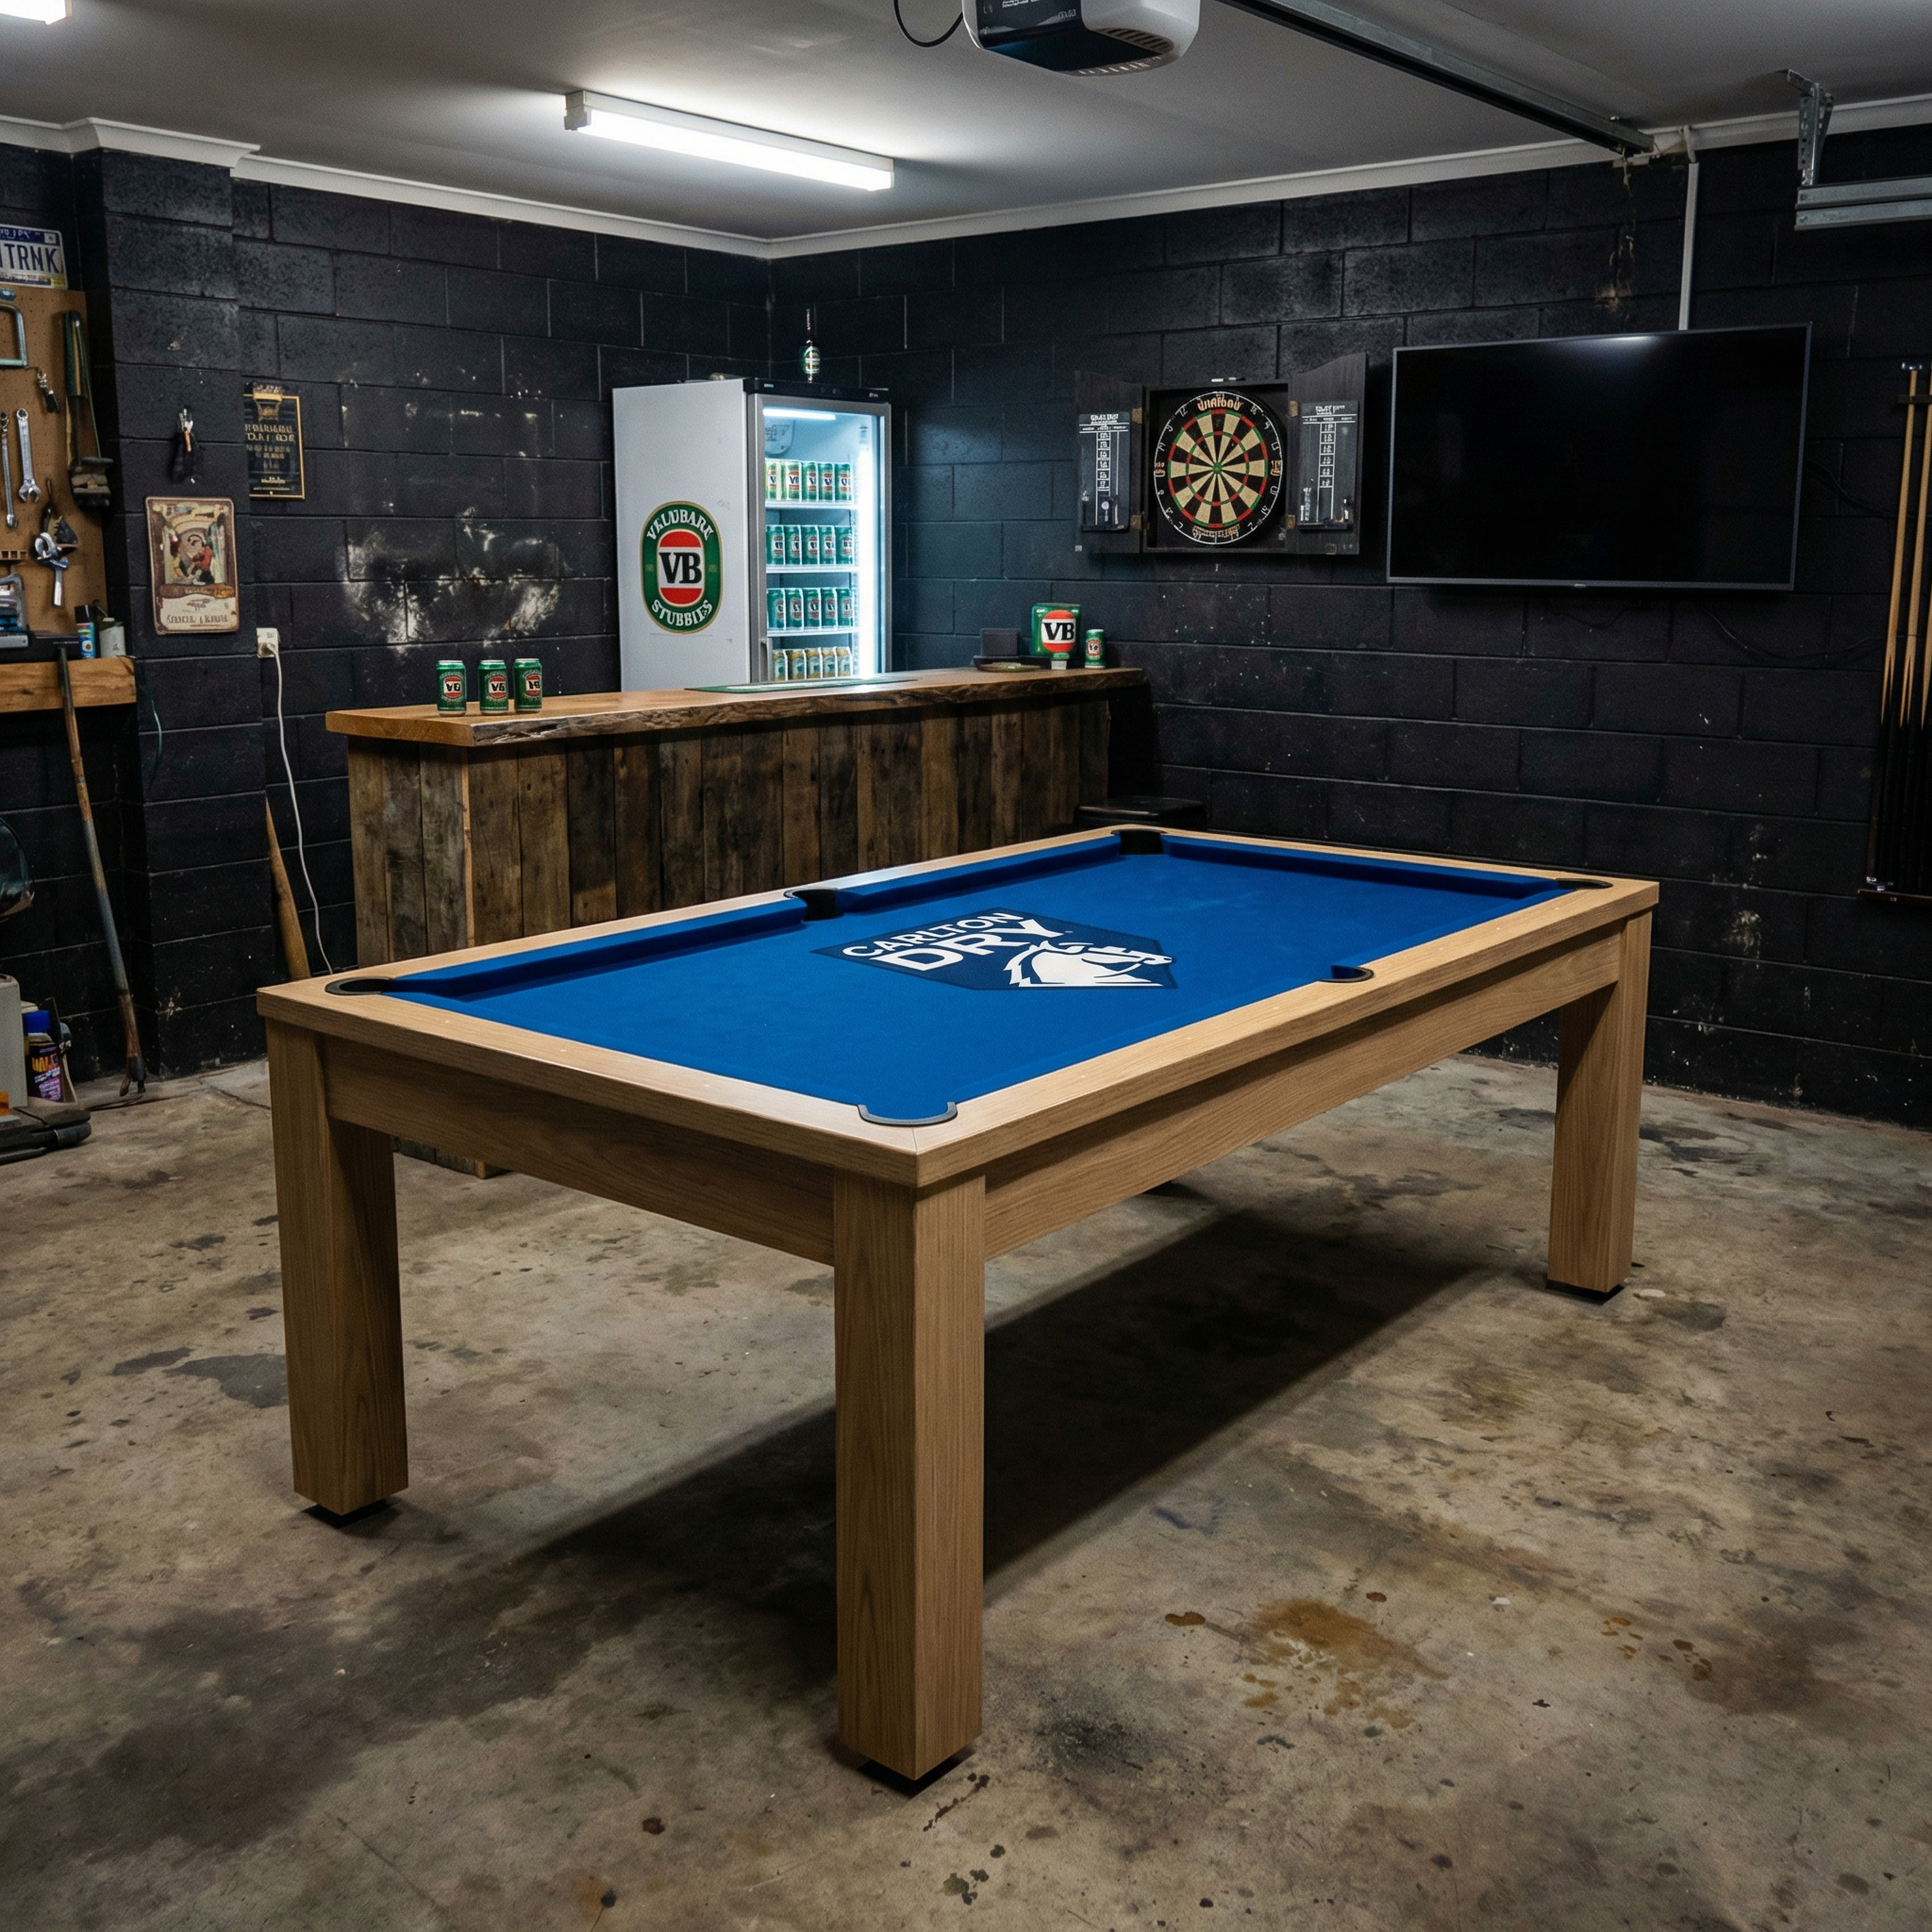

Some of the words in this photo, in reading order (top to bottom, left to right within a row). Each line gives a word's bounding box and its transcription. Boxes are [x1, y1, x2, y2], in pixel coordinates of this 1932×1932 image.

[658, 552, 703, 584] VB
[1043, 623, 1074, 641] VB
[841, 911, 1026, 957] CARLTON
[870, 918, 1065, 972] DRY
